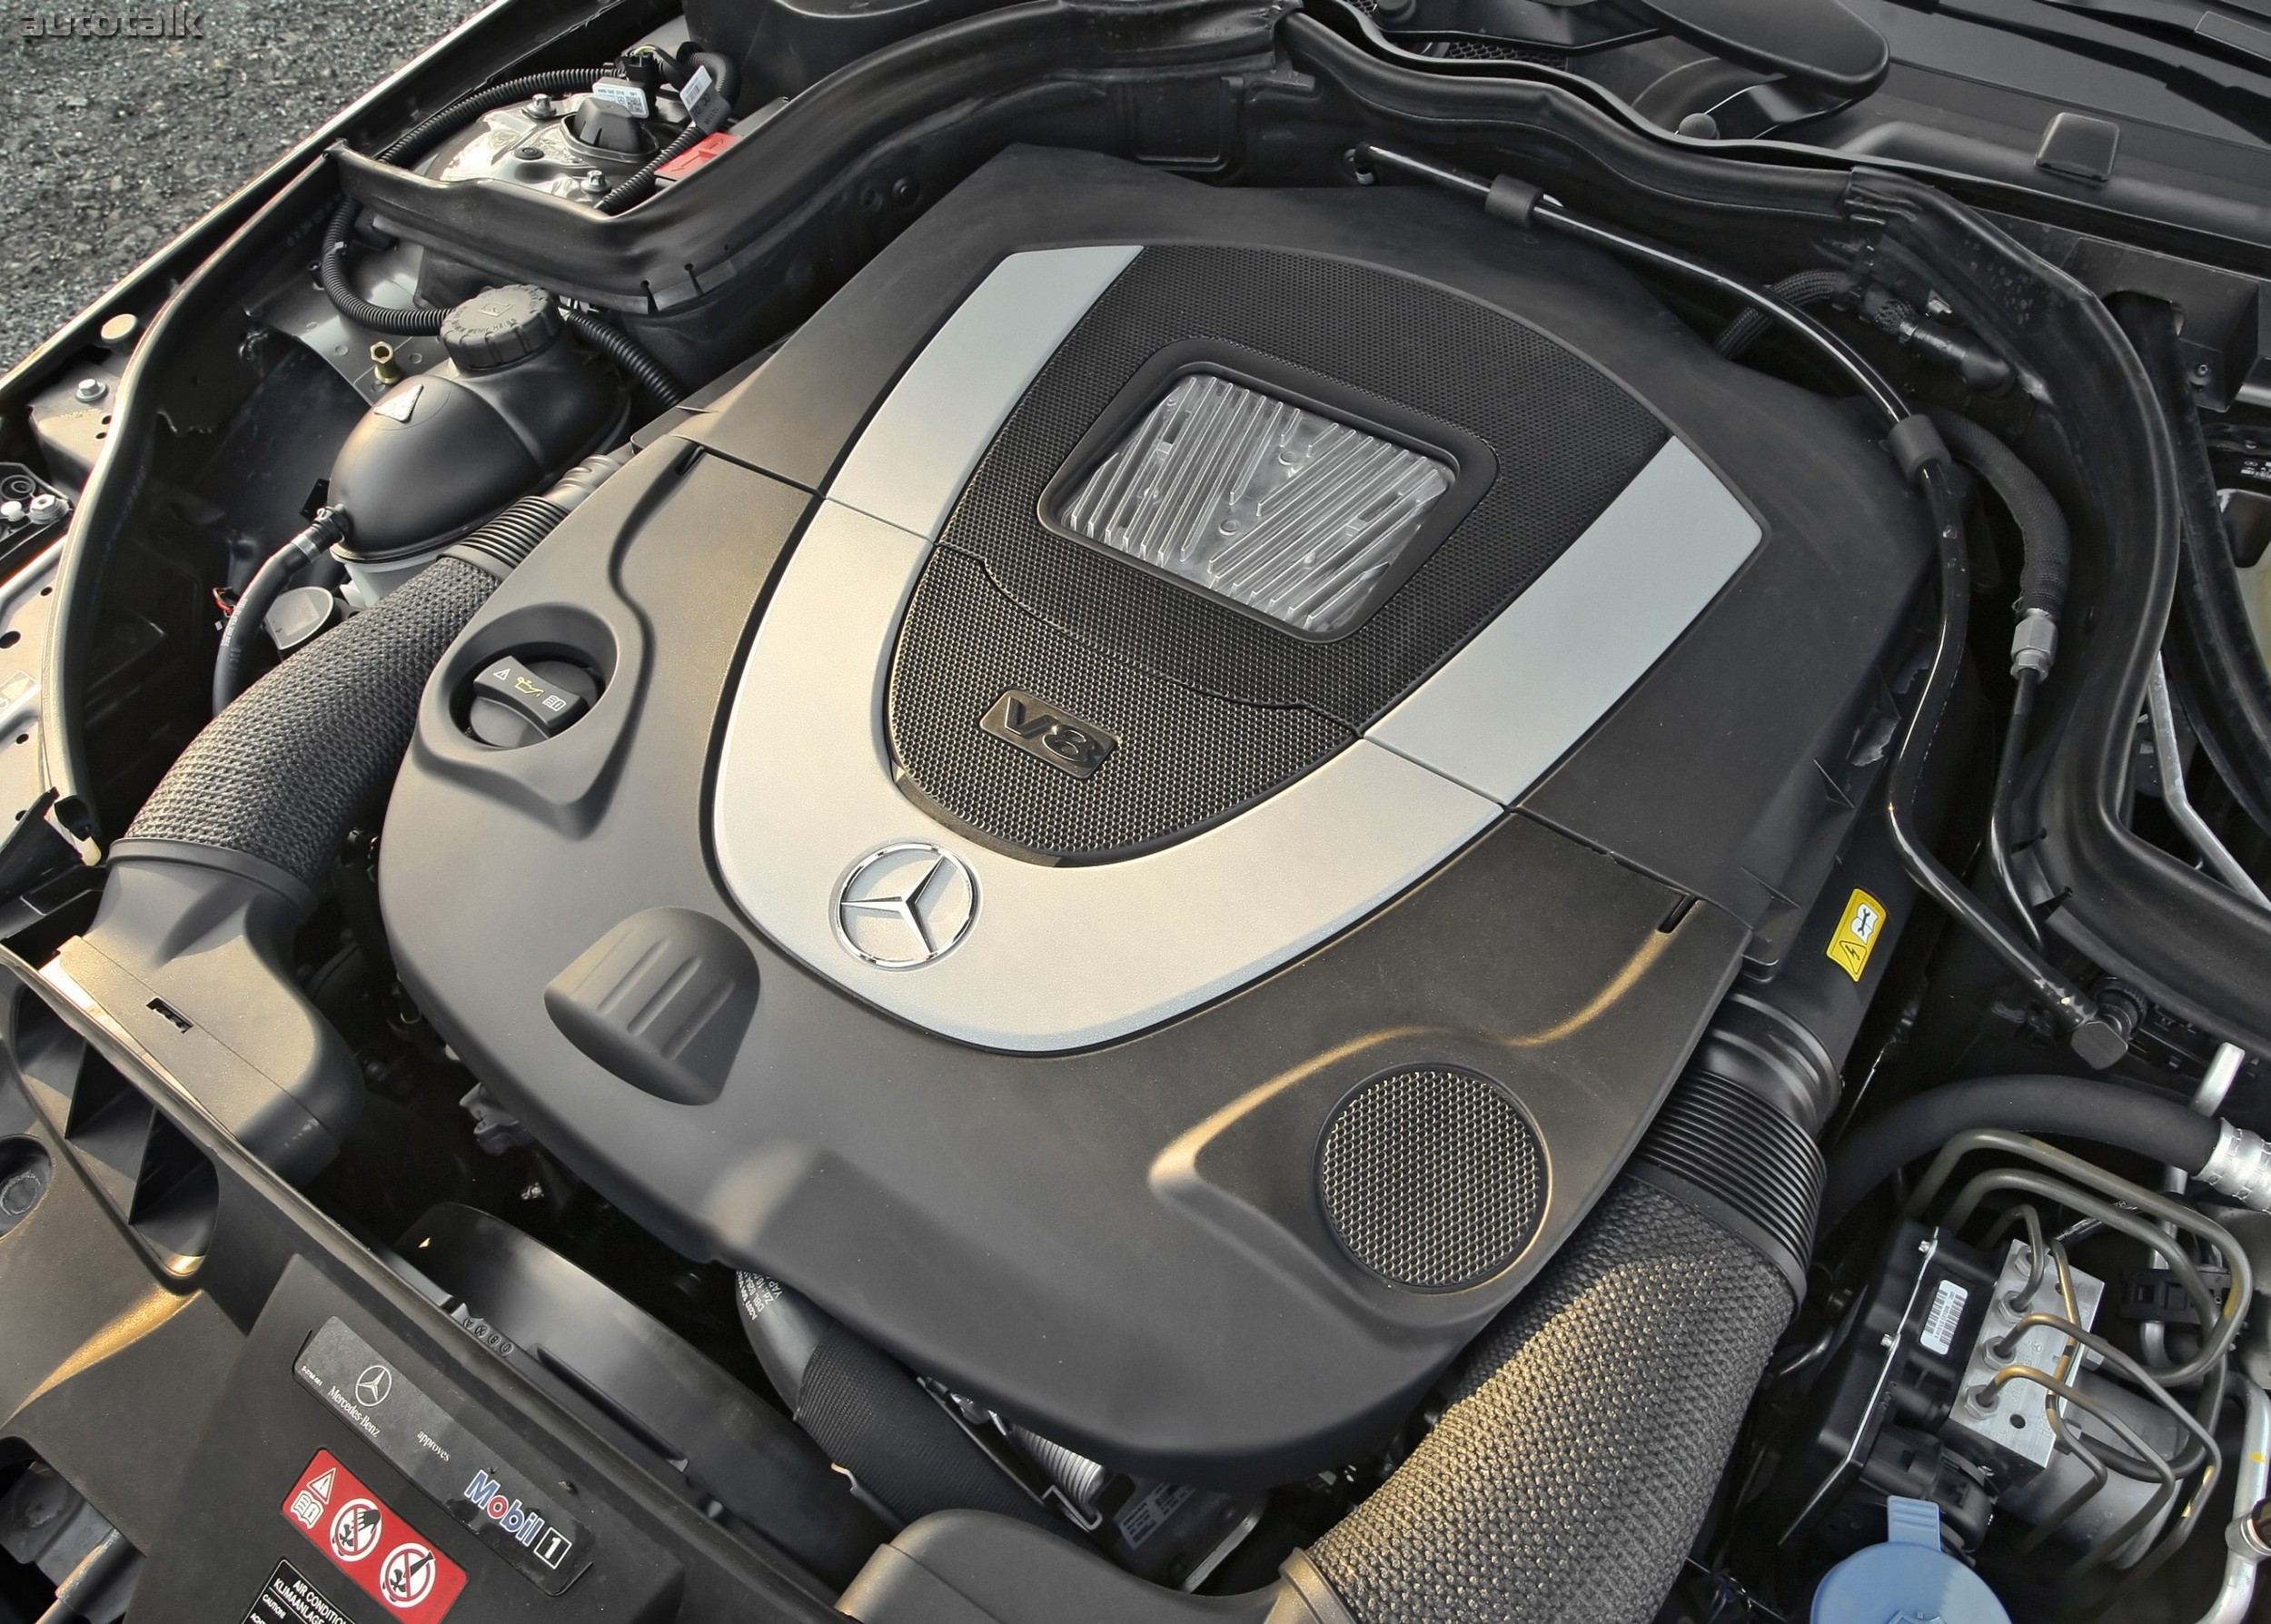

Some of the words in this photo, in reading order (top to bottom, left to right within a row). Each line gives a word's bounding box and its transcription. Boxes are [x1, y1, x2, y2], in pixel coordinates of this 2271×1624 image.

[1005, 696, 1103, 766] V8
[327, 1385, 382, 1439] Mercedes-Benz
[416, 1430, 451, 1463] approves
[463, 1469, 546, 1548] Mobil
[293, 1579, 308, 1597] AIR
[305, 1591, 347, 1624] CONDITIO
